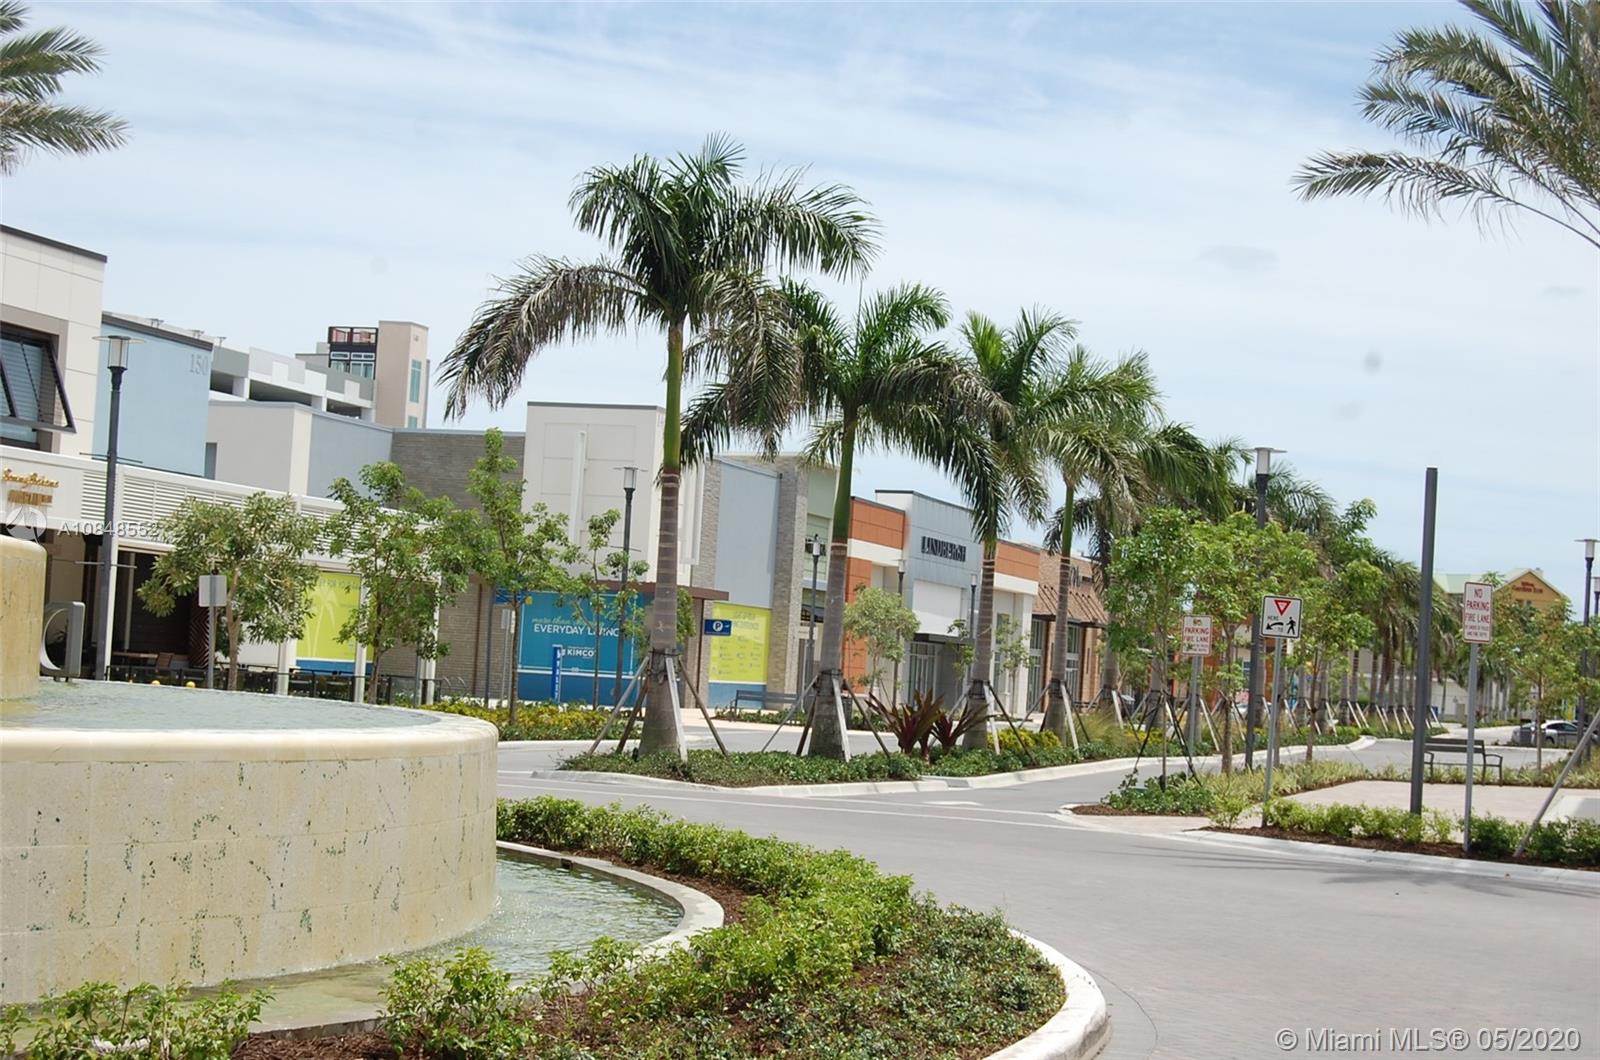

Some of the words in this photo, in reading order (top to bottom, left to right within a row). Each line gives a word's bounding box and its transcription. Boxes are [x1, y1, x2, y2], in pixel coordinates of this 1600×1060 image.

[190, 353, 209, 376] 150
[921, 535, 967, 562] LINDBERGH
[1466, 600, 1490, 612] PARKING
[1465, 612, 1477, 622] FIRE
[1477, 613, 1490, 624] LANE
[533, 623, 585, 635] EVERYDAY
[1184, 627, 1210, 635] PARKING
[567, 649, 595, 658] KIMCO
